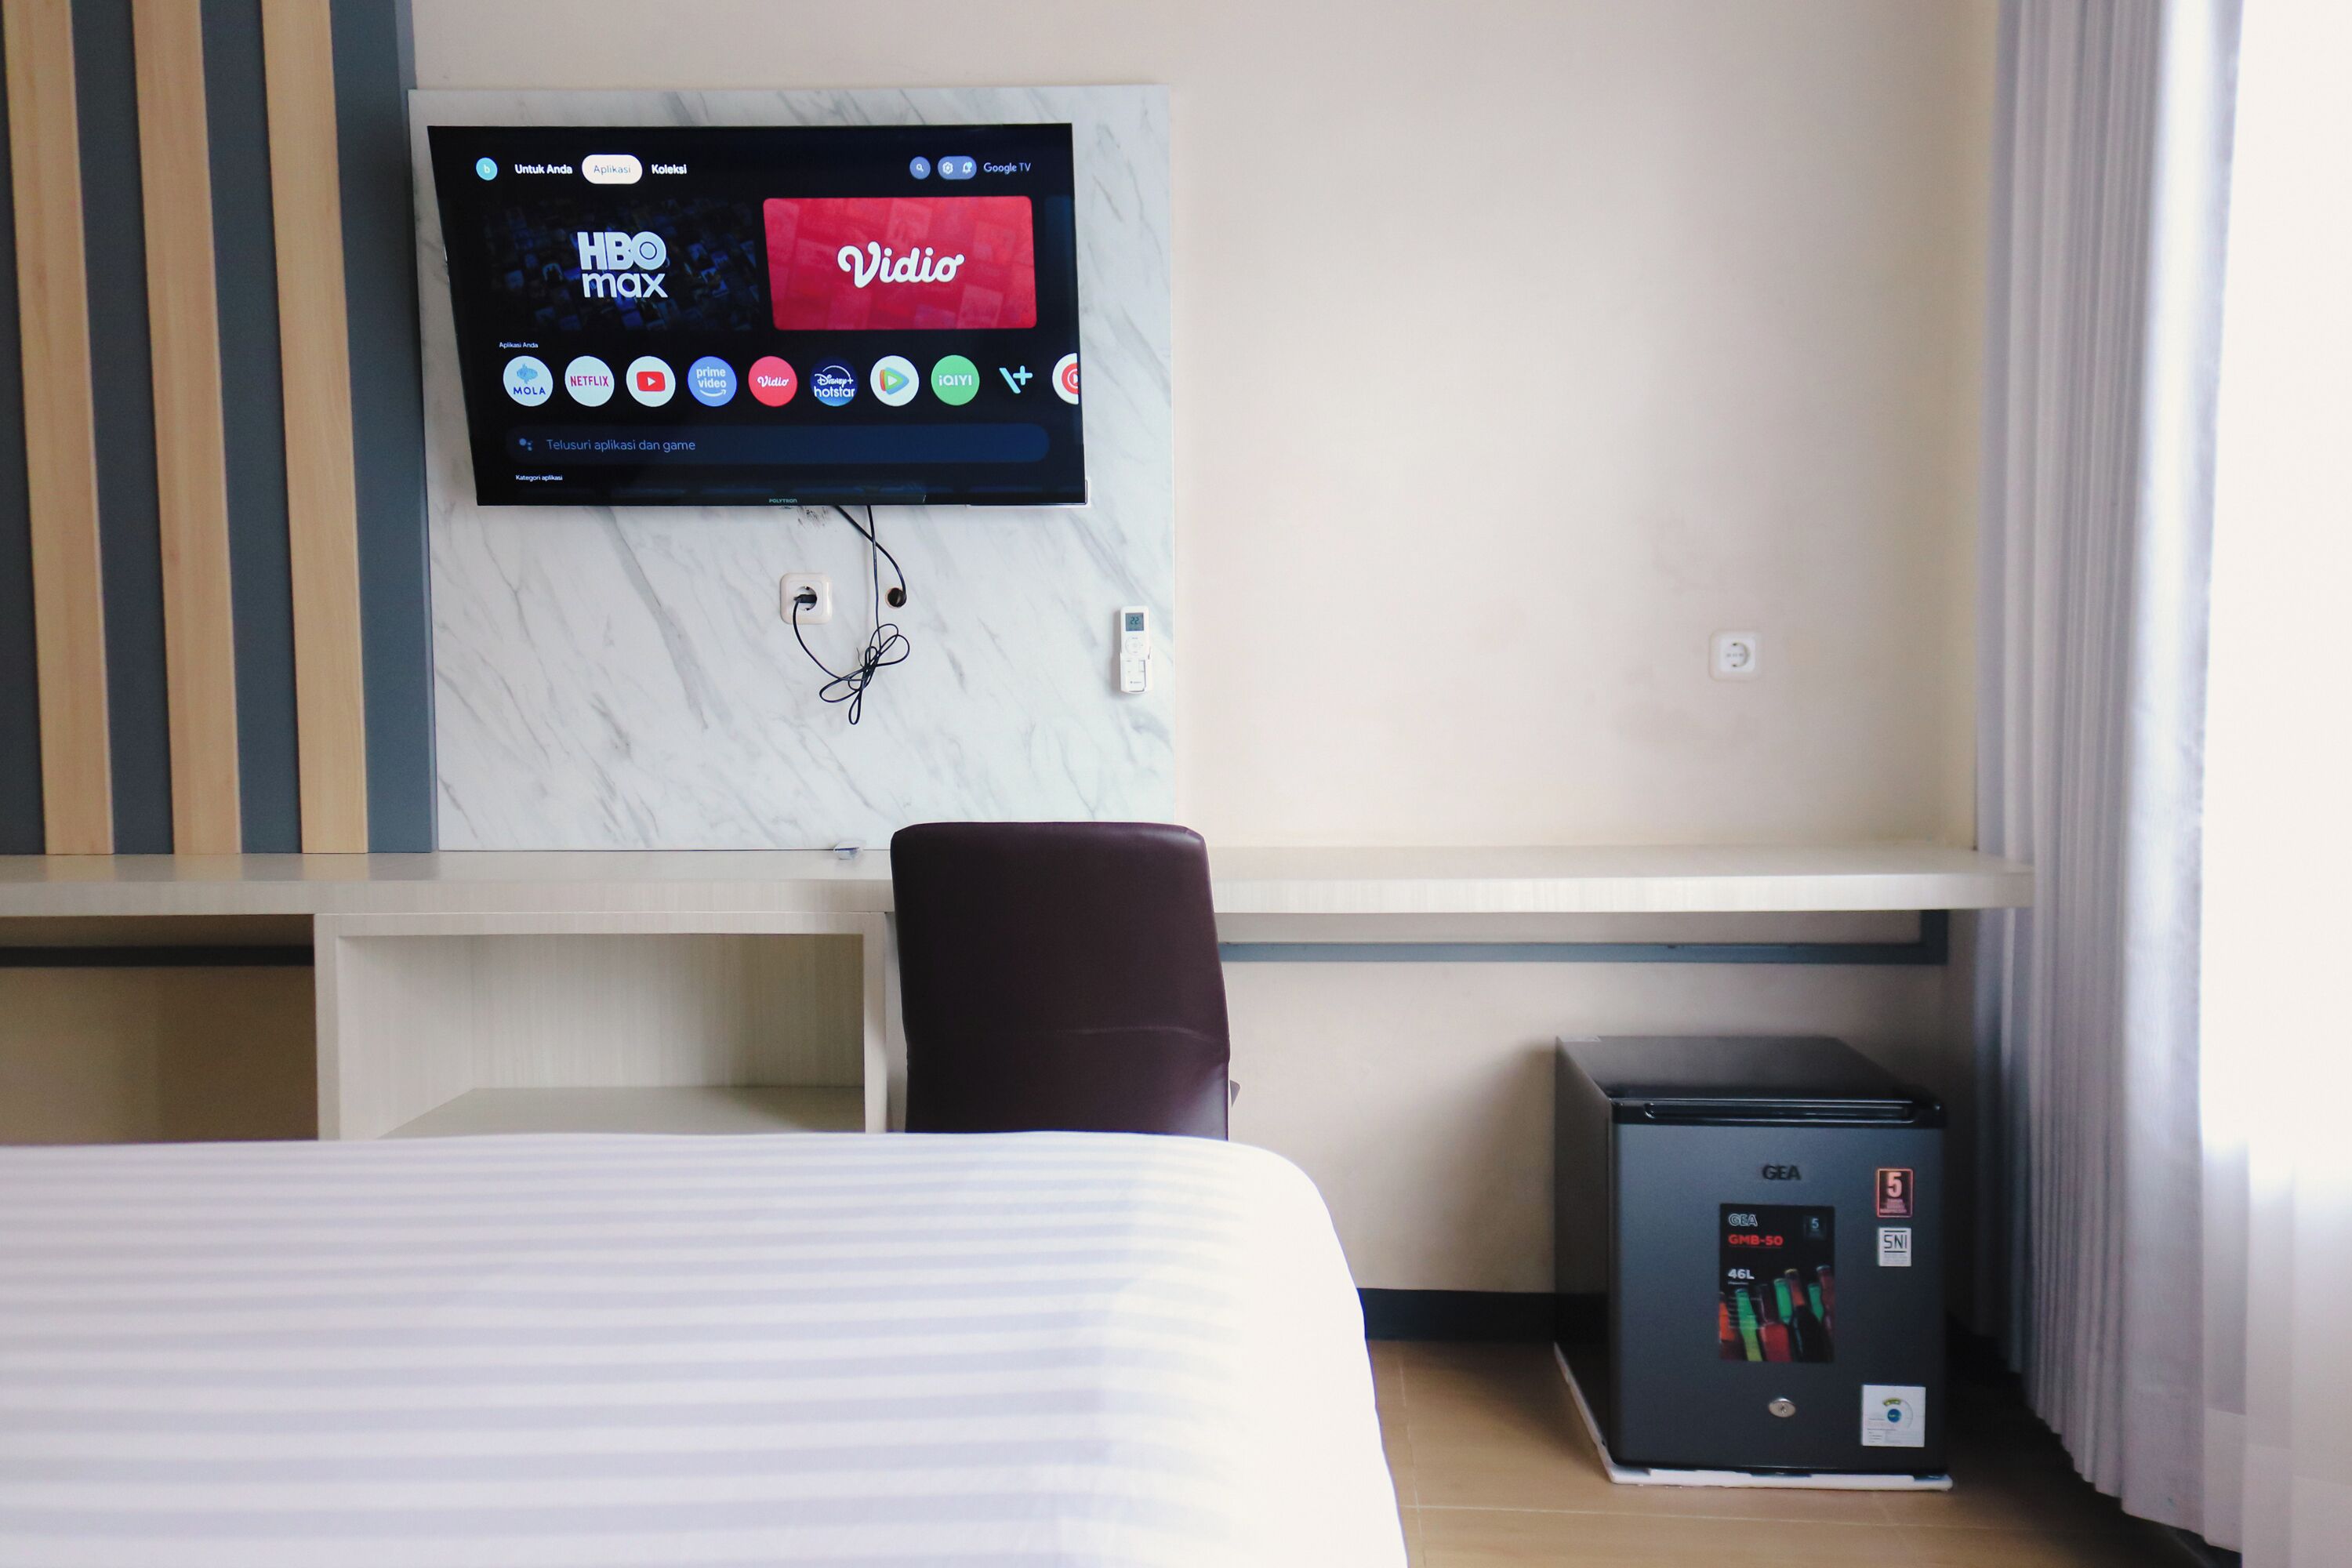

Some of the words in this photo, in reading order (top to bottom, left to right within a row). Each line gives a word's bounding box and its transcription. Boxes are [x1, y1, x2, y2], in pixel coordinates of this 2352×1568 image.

[514, 164, 546, 174] Untuk
[546, 164, 573, 174] Anda
[593, 164, 631, 176] Aplikasi
[652, 164, 687, 174] Koleksi
[983, 162, 1017, 175] Google
[1018, 162, 1031, 172] TV
[577, 231, 666, 270] HBO
[837, 241, 965, 289] Vidio
[583, 273, 668, 298] max
[696, 368, 726, 379] prime
[814, 372, 854, 387] Disney+
[570, 376, 609, 387] NETFLIX
[698, 377, 727, 388] video
[757, 376, 789, 388] Vidio
[514, 387, 546, 395] MOLA
[814, 386, 855, 397] hotstar
[546, 439, 590, 450] Telusuri
[594, 438, 636, 452] aplikasi
[640, 439, 660, 450] dan
[663, 441, 695, 452] game
[515, 474, 540, 482] Kategori
[1762, 1165, 1802, 1180] GEA
[1886, 1171, 1903, 1198] 5
[1728, 1213, 1759, 1227] GEA
[1811, 1218, 1819, 1229] 5
[1727, 1234, 1784, 1247] GMB-50
[1884, 1234, 1907, 1249] SNI
[1727, 1269, 1755, 1280] 46L
